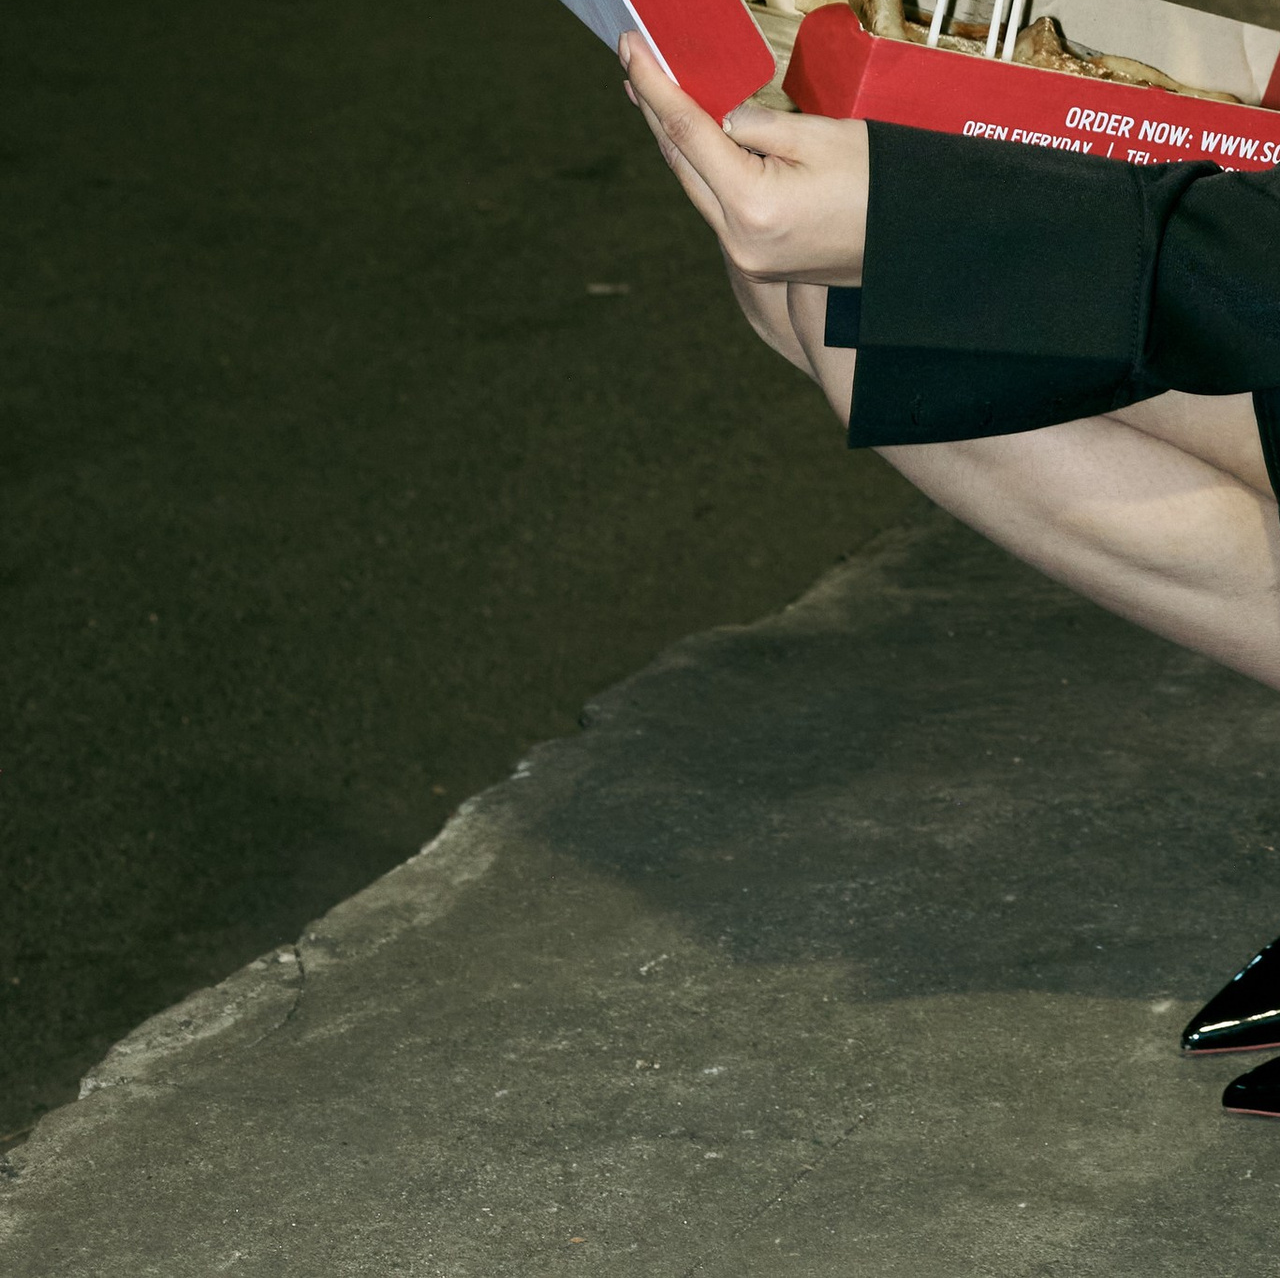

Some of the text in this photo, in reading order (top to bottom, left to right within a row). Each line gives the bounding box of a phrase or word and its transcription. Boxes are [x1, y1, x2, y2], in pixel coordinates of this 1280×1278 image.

[962, 120, 1009, 141] OPEN
[1010, 128, 1094, 155] EVERYDAY
[1065, 106, 1135, 139] ORDER
[1137, 119, 1194, 149] NOW:
